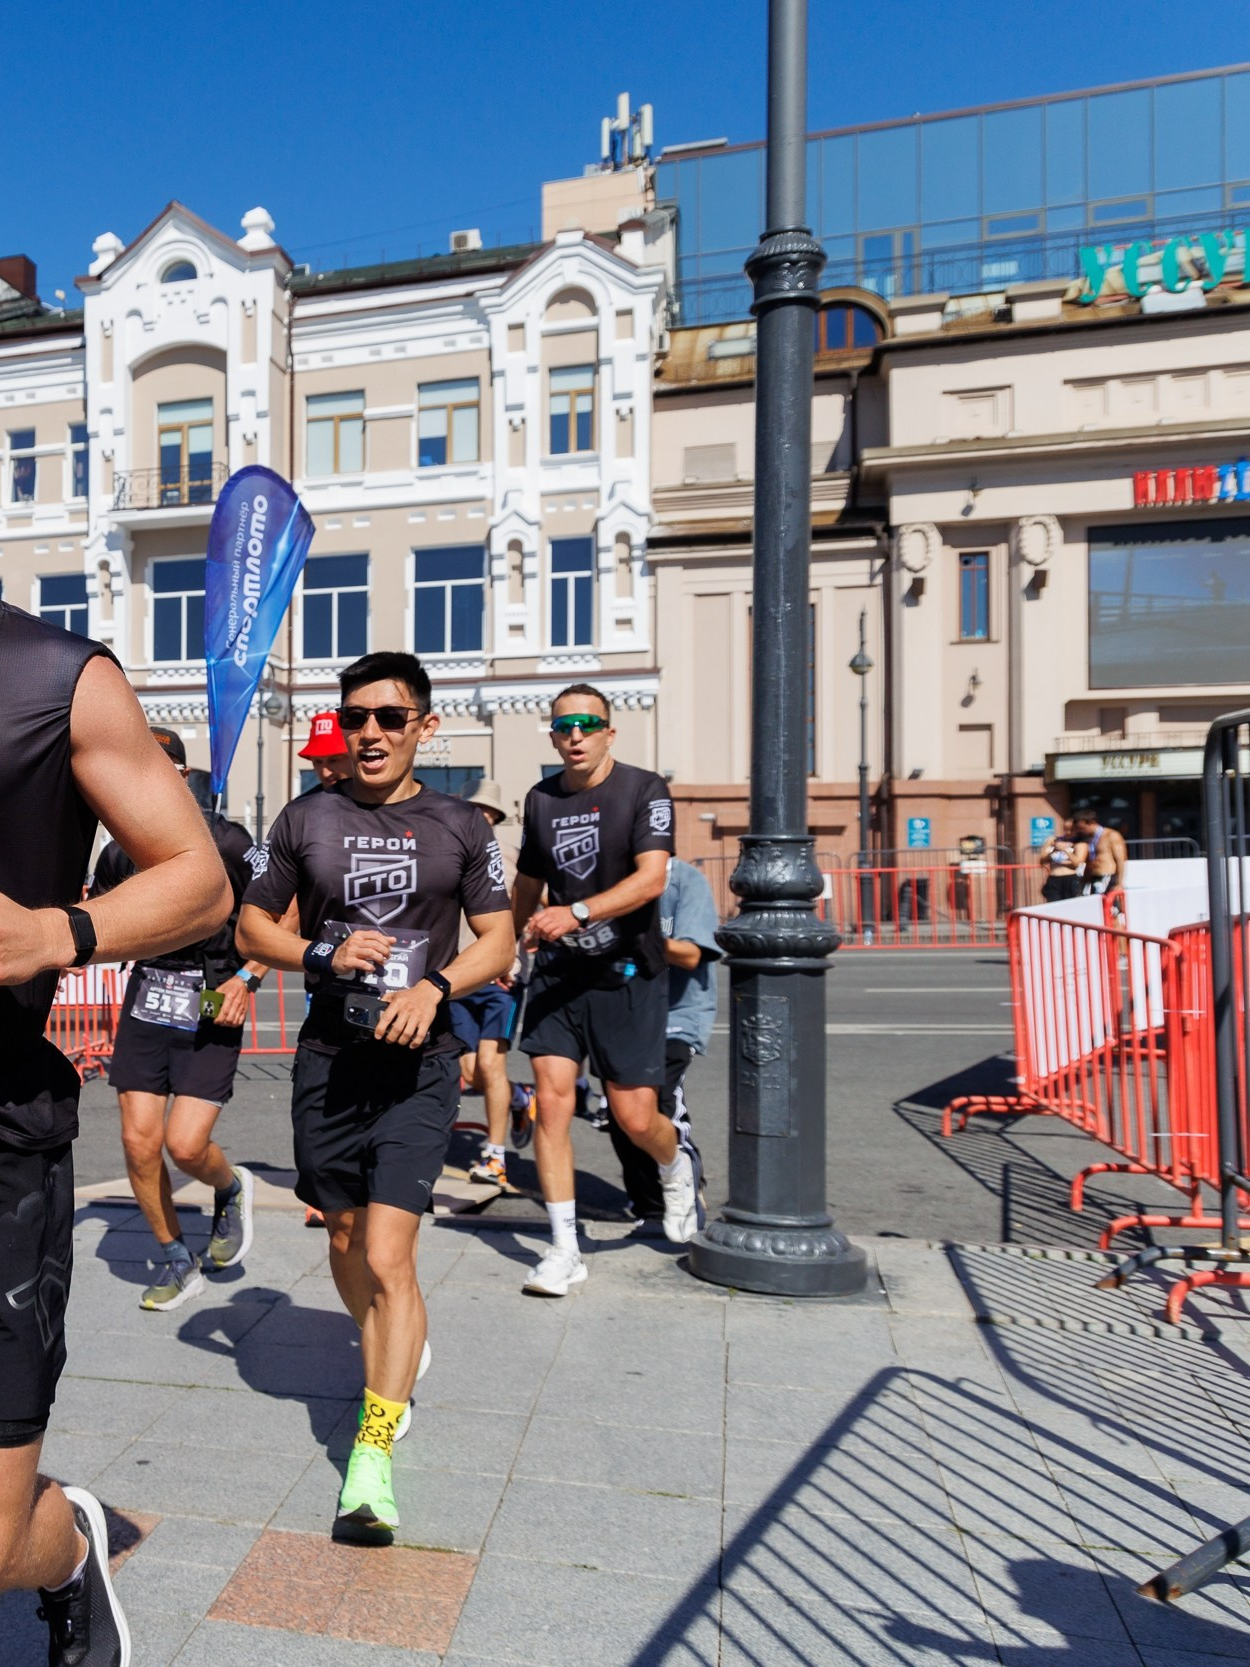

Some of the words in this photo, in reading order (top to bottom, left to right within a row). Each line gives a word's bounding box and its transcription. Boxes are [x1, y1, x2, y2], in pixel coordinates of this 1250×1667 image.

[1079, 227, 1250, 305] УССУ
[233, 494, 269, 668] спортлото
[343, 830, 417, 851] ГЕРОЙ
[559, 836, 594, 863] ГТО
[353, 868, 408, 899] ГТО
[145, 991, 190, 1015] 517
